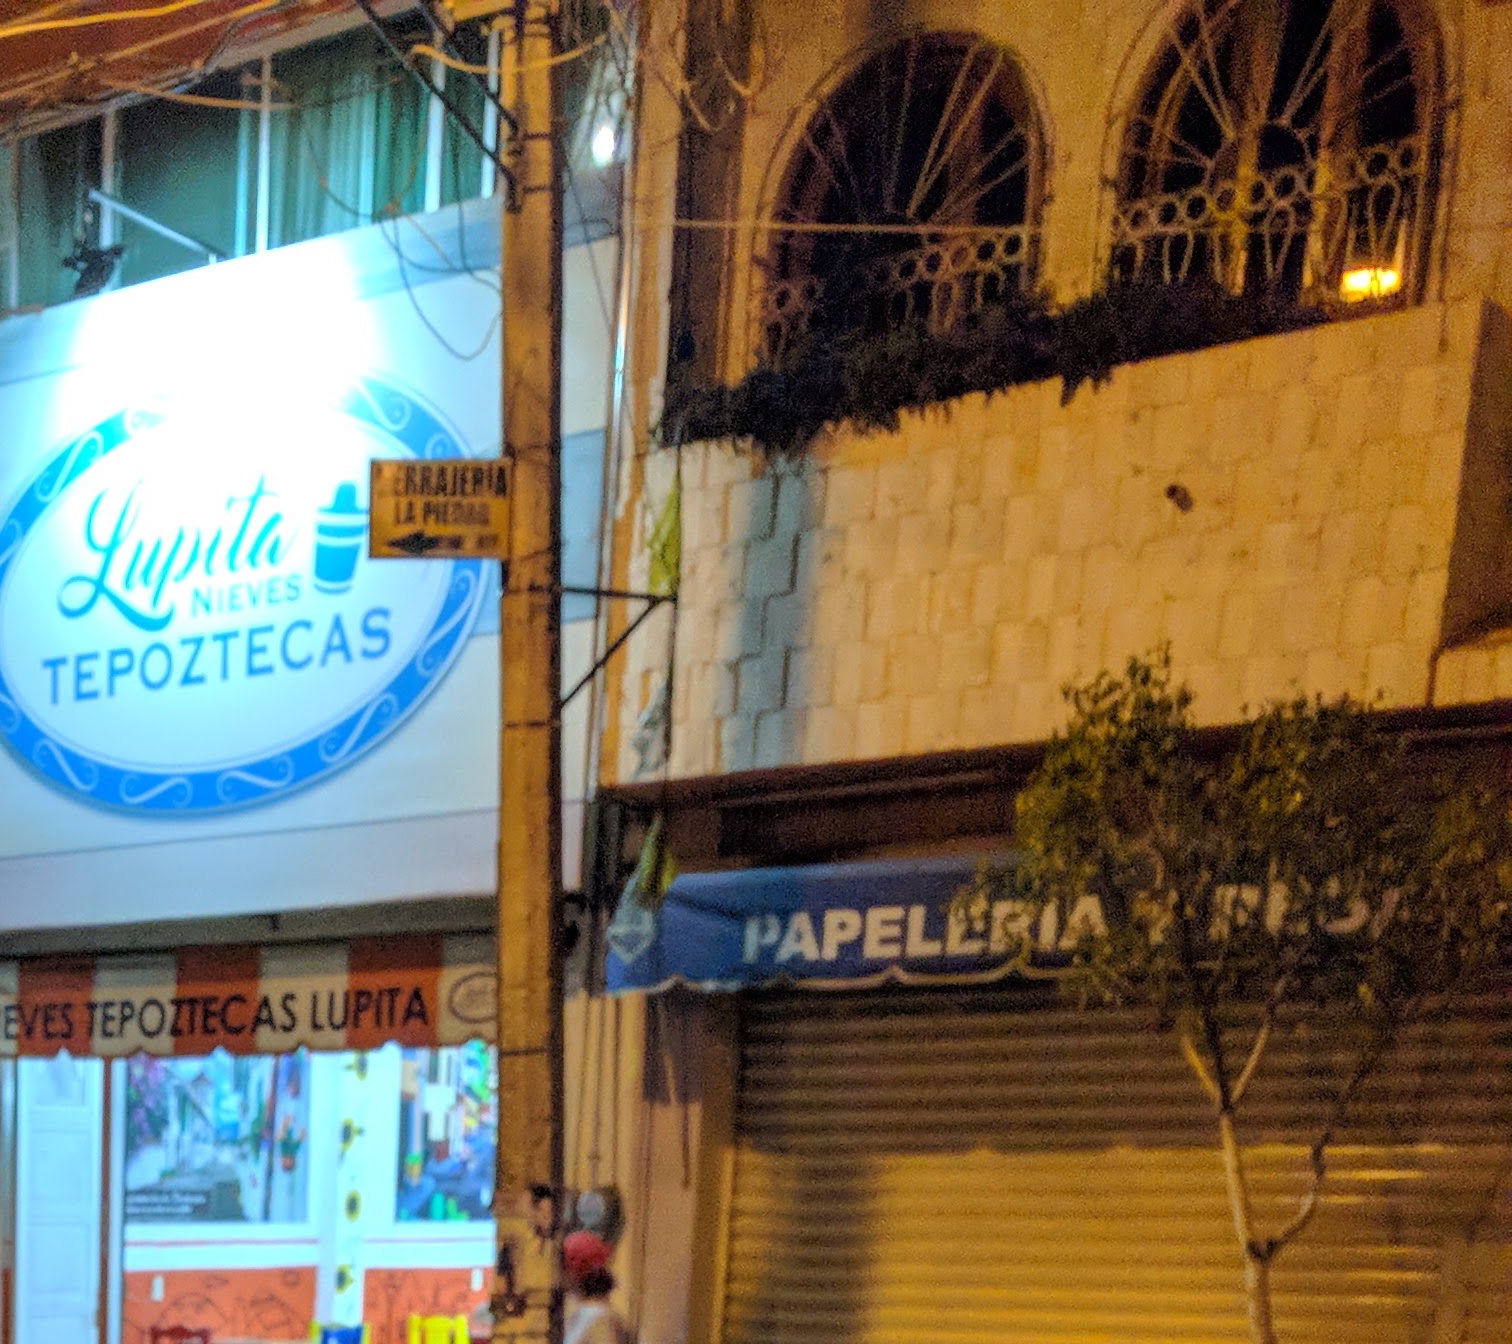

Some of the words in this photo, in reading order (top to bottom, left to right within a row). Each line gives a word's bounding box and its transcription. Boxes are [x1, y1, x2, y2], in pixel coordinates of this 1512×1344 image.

[375, 463, 507, 497] ERRAJERIA
[57, 473, 296, 632] Lupita
[190, 573, 304, 618] NIEVES
[40, 607, 392, 706] TEPOZTECAS
[741, 893, 1110, 964] PAPELERIA
[91, 994, 297, 1038] TEPOZTECAS
[311, 986, 429, 1033] LUPITA
